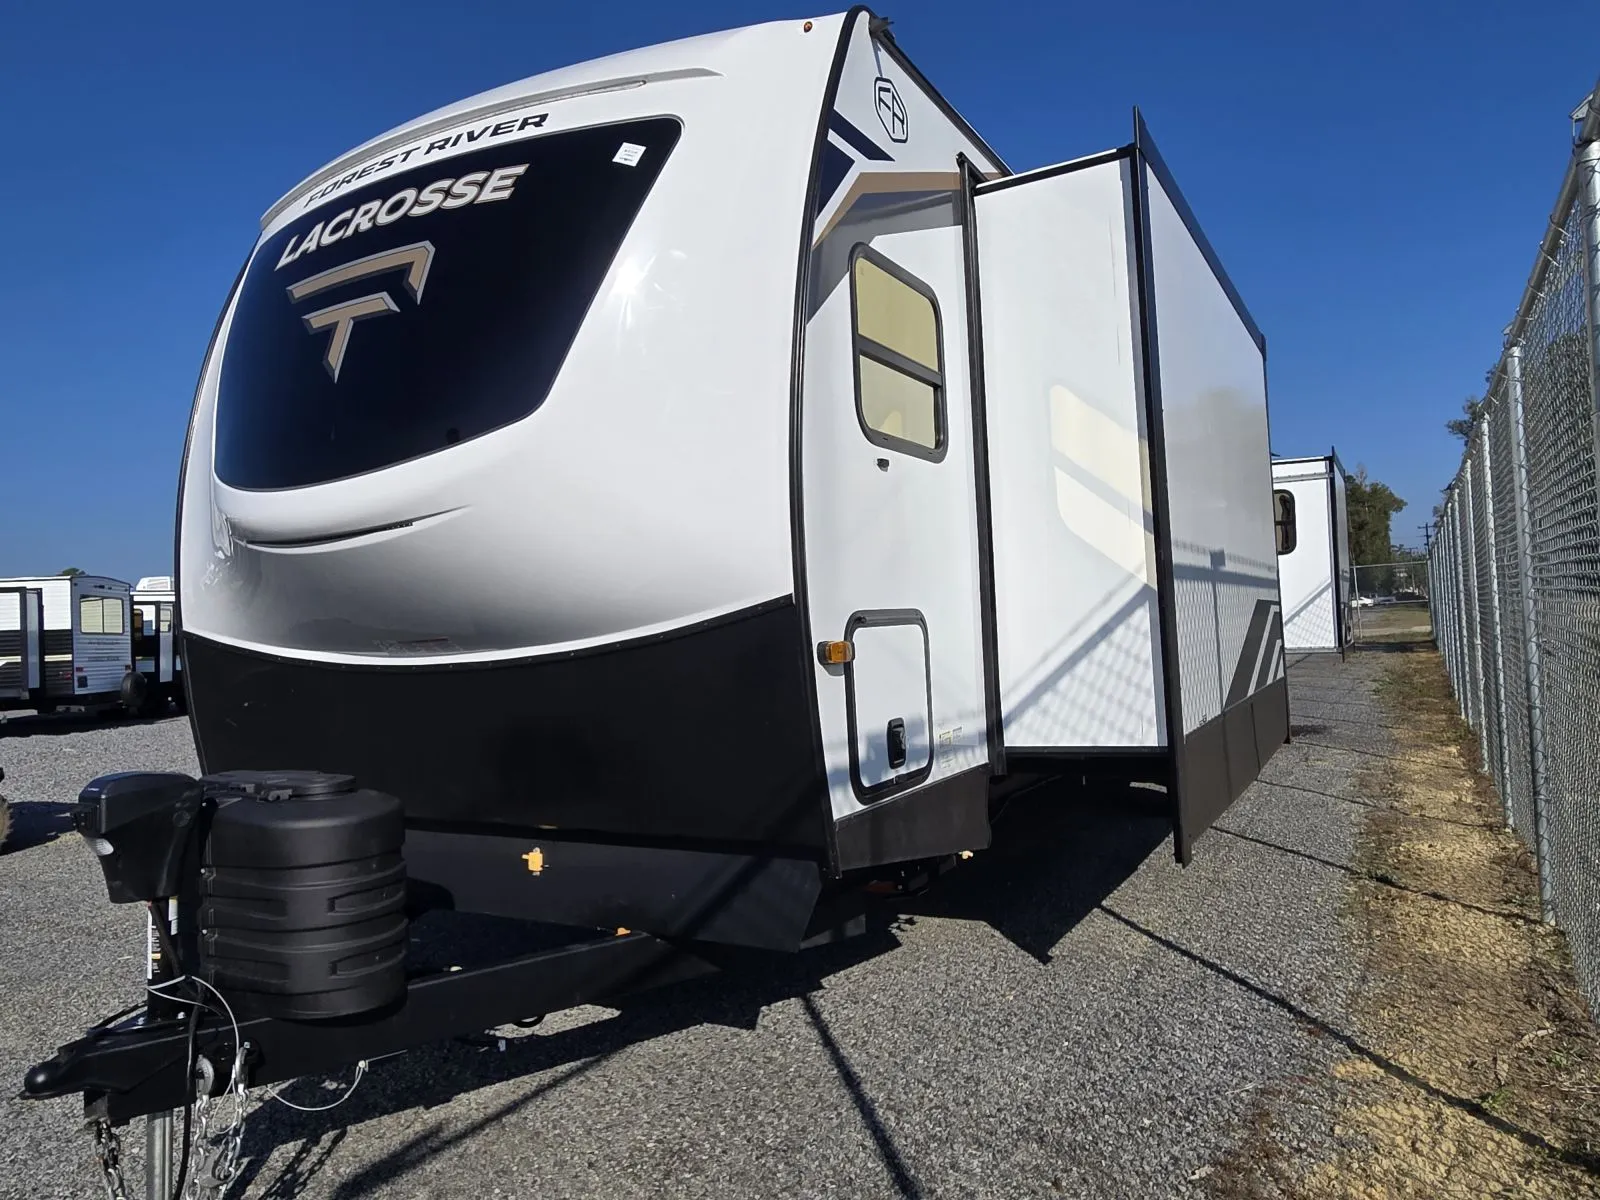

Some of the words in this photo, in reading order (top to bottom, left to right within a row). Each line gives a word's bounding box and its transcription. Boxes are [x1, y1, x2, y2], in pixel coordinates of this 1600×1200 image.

[304, 146, 421, 208] FOREST
[424, 112, 549, 155] RIVER
[274, 163, 531, 272] LACROSSE
